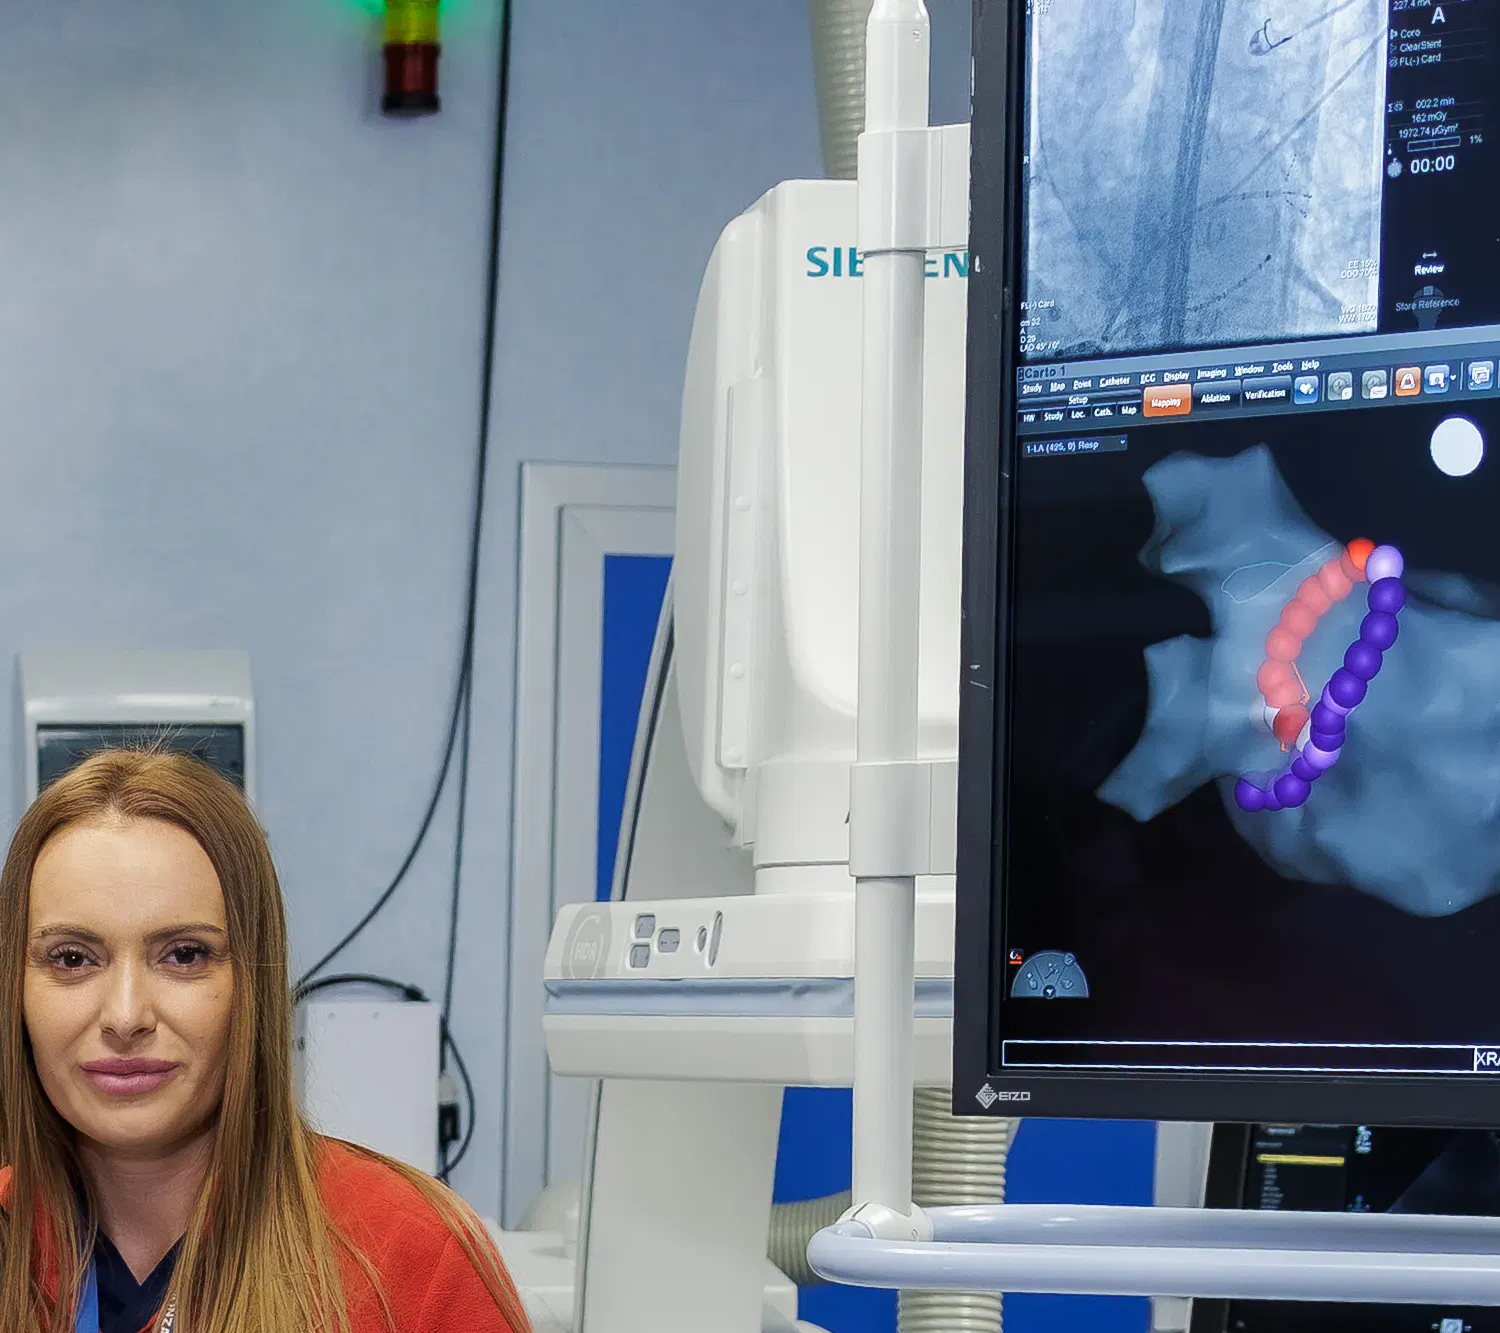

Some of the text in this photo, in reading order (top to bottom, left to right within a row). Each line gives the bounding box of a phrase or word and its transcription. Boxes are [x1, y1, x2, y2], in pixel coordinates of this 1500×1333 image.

[1431, 7, 1446, 24] A
[1400, 40, 1442, 52] ClearStent
[1421, 54, 1441, 65] Card
[1440, 97, 1455, 107] min
[1412, 111, 1447, 123] 162 mGy
[1470, 134, 1483, 144] 1%
[1411, 155, 1455, 174] 00:00
[806, 246, 969, 278] SIEEN
[1414, 263, 1445, 276] Review
[1395, 297, 1460, 312] Store Reference
[1022, 359, 1320, 394] Study Map Point Catheter ECG Display Imaging Window Tools Help
[1024, 365, 1066, 379] Carto 1
[1068, 395, 1089, 405] Setup
[1201, 393, 1231, 403] Ablation
[1245, 388, 1286, 400] Verification
[1151, 396, 1182, 409] Mapping
[1044, 411, 1064, 421] Study
[1071, 409, 1086, 419] Loc.
[1094, 407, 1113, 417] Cath.
[1121, 405, 1138, 415] Map
[998, 1091, 1031, 1101] EIZO
